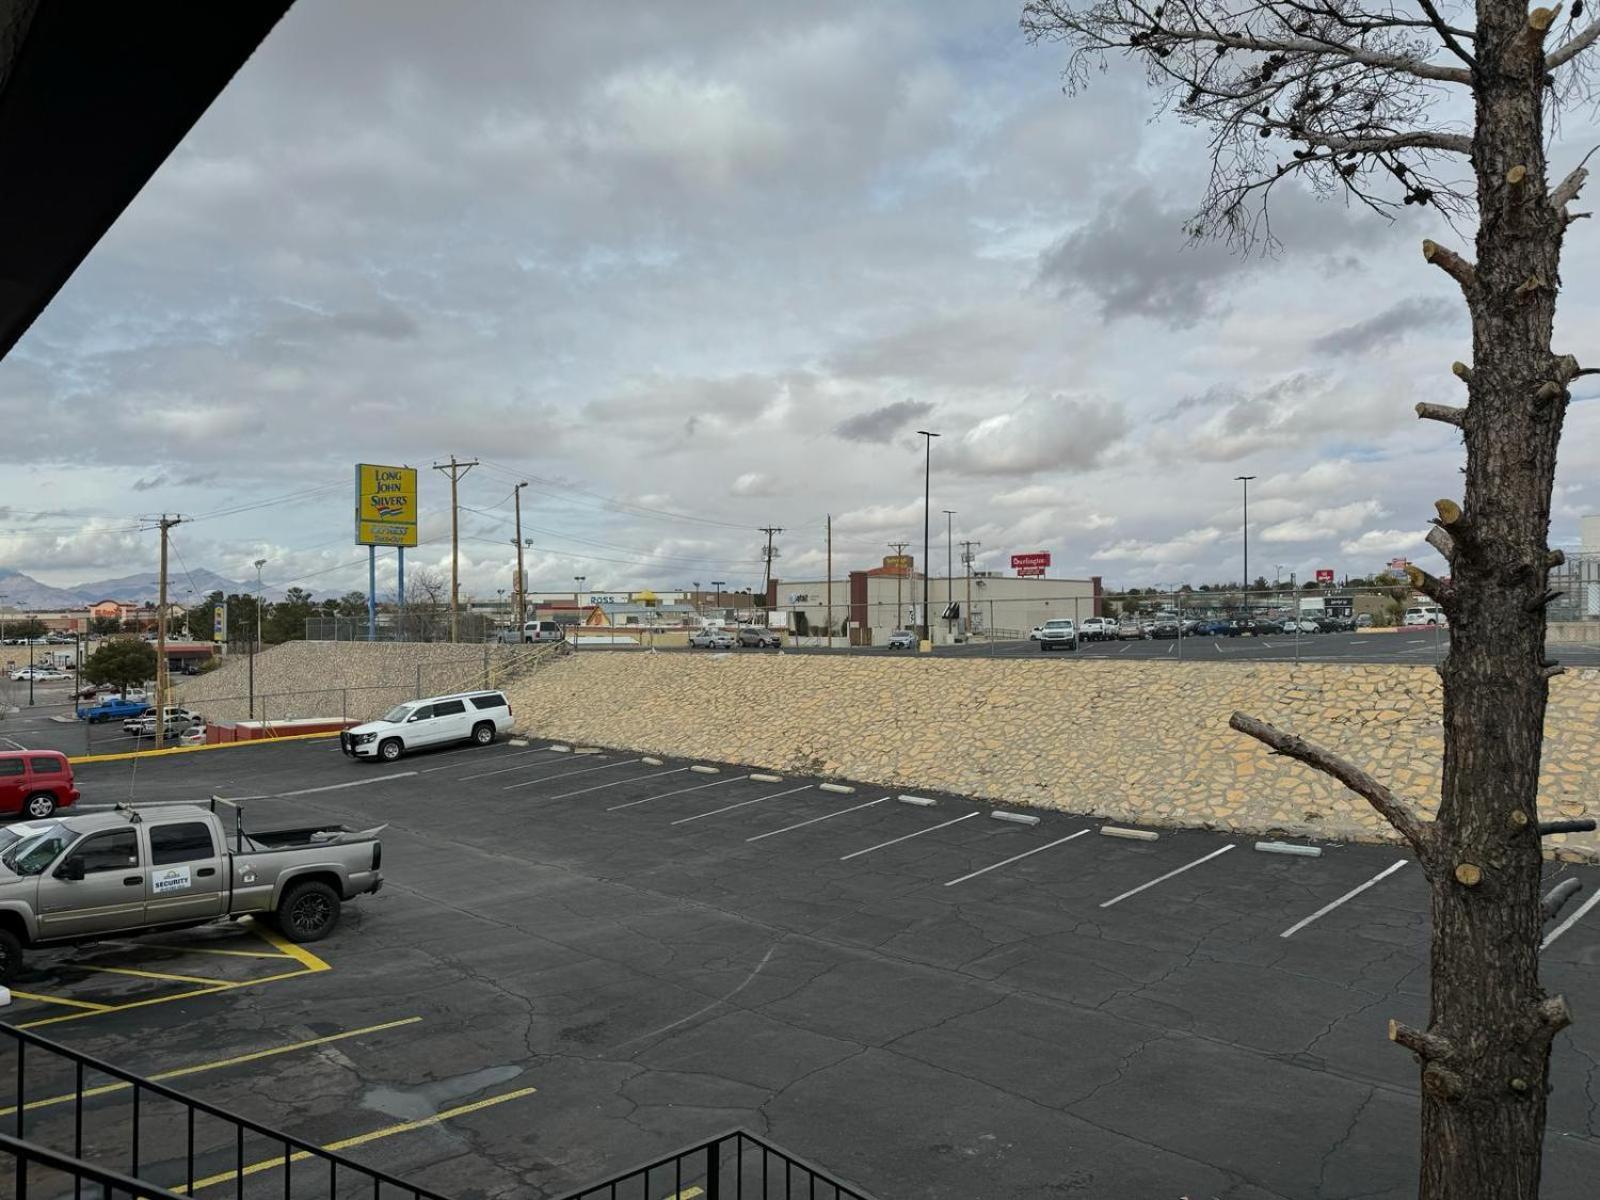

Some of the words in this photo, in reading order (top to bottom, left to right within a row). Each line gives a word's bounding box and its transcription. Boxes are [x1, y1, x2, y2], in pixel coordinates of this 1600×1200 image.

[375, 470, 402, 481] LONG
[377, 481, 401, 493] JOHN
[591, 596, 615, 604] ROSS
[155, 877, 188, 889] SECURITY
